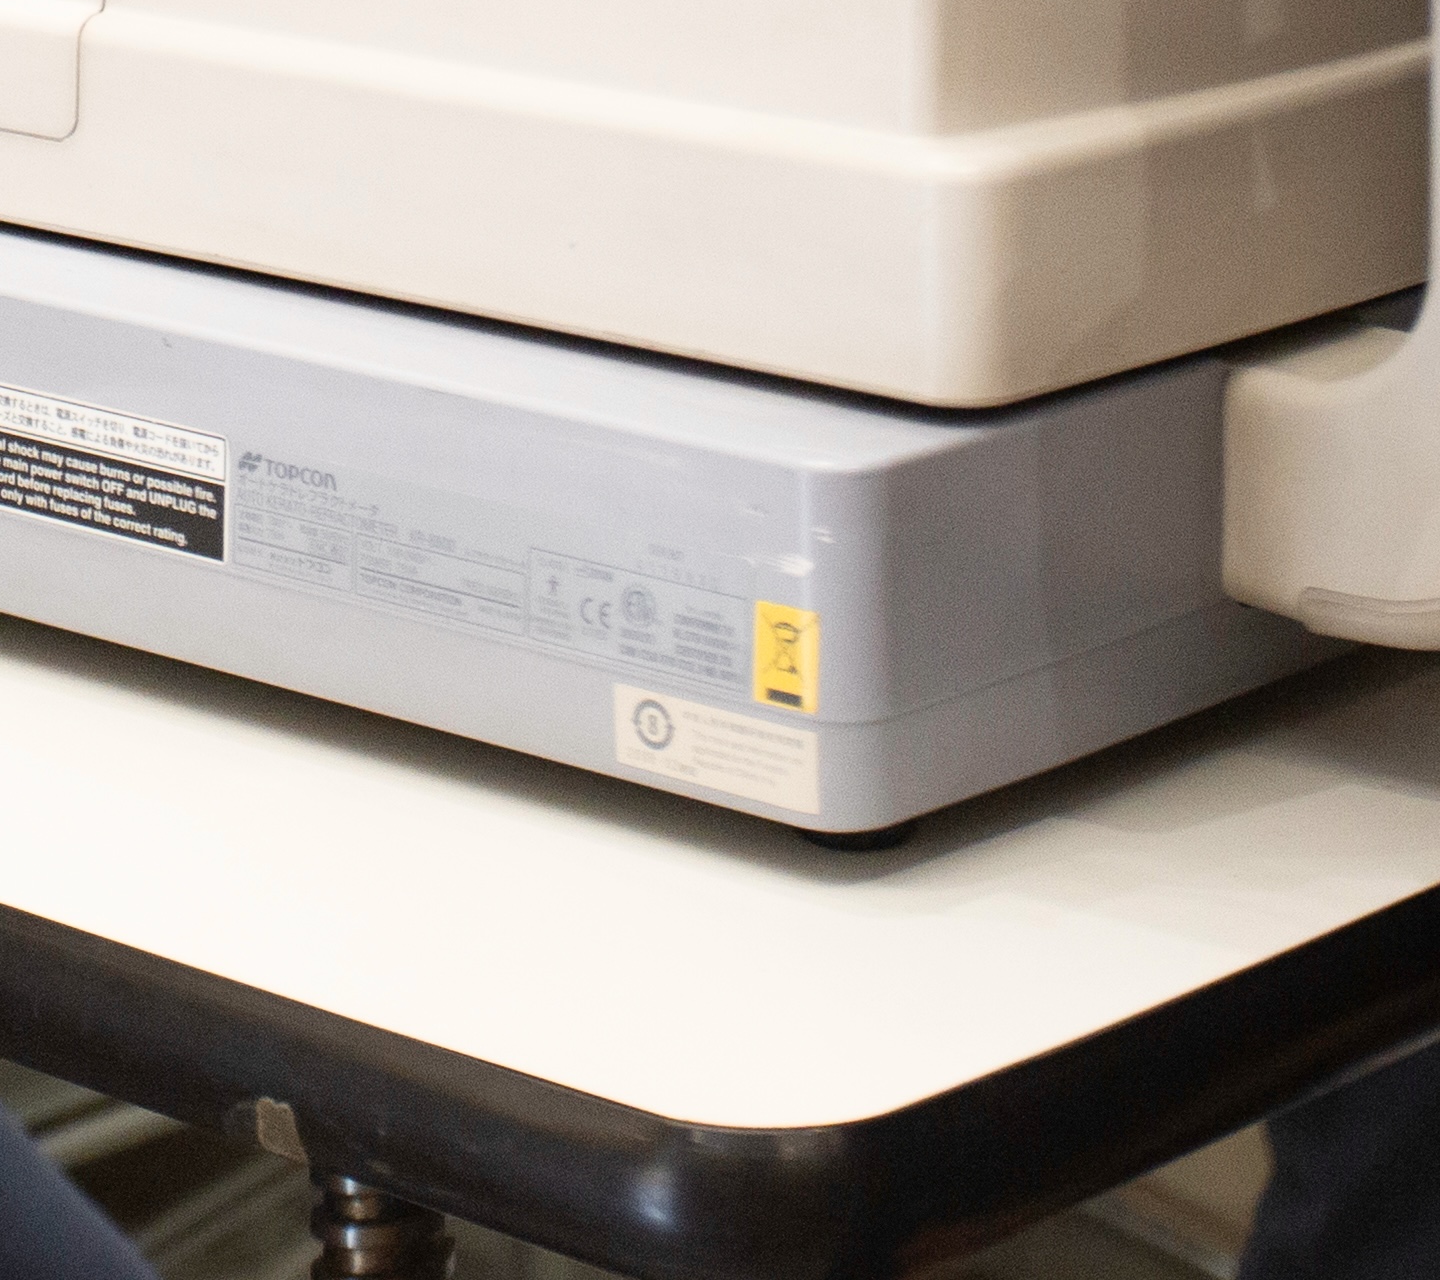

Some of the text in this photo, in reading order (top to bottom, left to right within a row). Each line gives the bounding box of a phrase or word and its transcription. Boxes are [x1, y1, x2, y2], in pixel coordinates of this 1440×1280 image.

[2, 456, 28, 472] main
[30, 464, 62, 483] power
[65, 471, 98, 489] switch
[102, 480, 124, 495] OFF
[126, 486, 146, 501] and
[148, 491, 196, 514] UNPLUG
[198, 504, 216, 518] the
[7, 440, 39, 458] shock
[41, 451, 62, 467] may
[66, 457, 96, 472] cause
[99, 463, 129, 481] burns
[132, 473, 144, 484] or
[146, 475, 192, 498] possible
[194, 486, 216, 502] fire.
[17, 474, 50, 493] before
[52, 484, 101, 508] replacing
[103, 497, 136, 515] fuses.
[264, 458, 337, 492] TOPCON
[0, 488, 22, 505] only
[25, 493, 47, 508] with
[49, 499, 78, 515] fuses
[81, 507, 91, 519] of
[94, 511, 110, 524] the
[113, 516, 151, 534] correct
[153, 525, 187, 547] rating.
